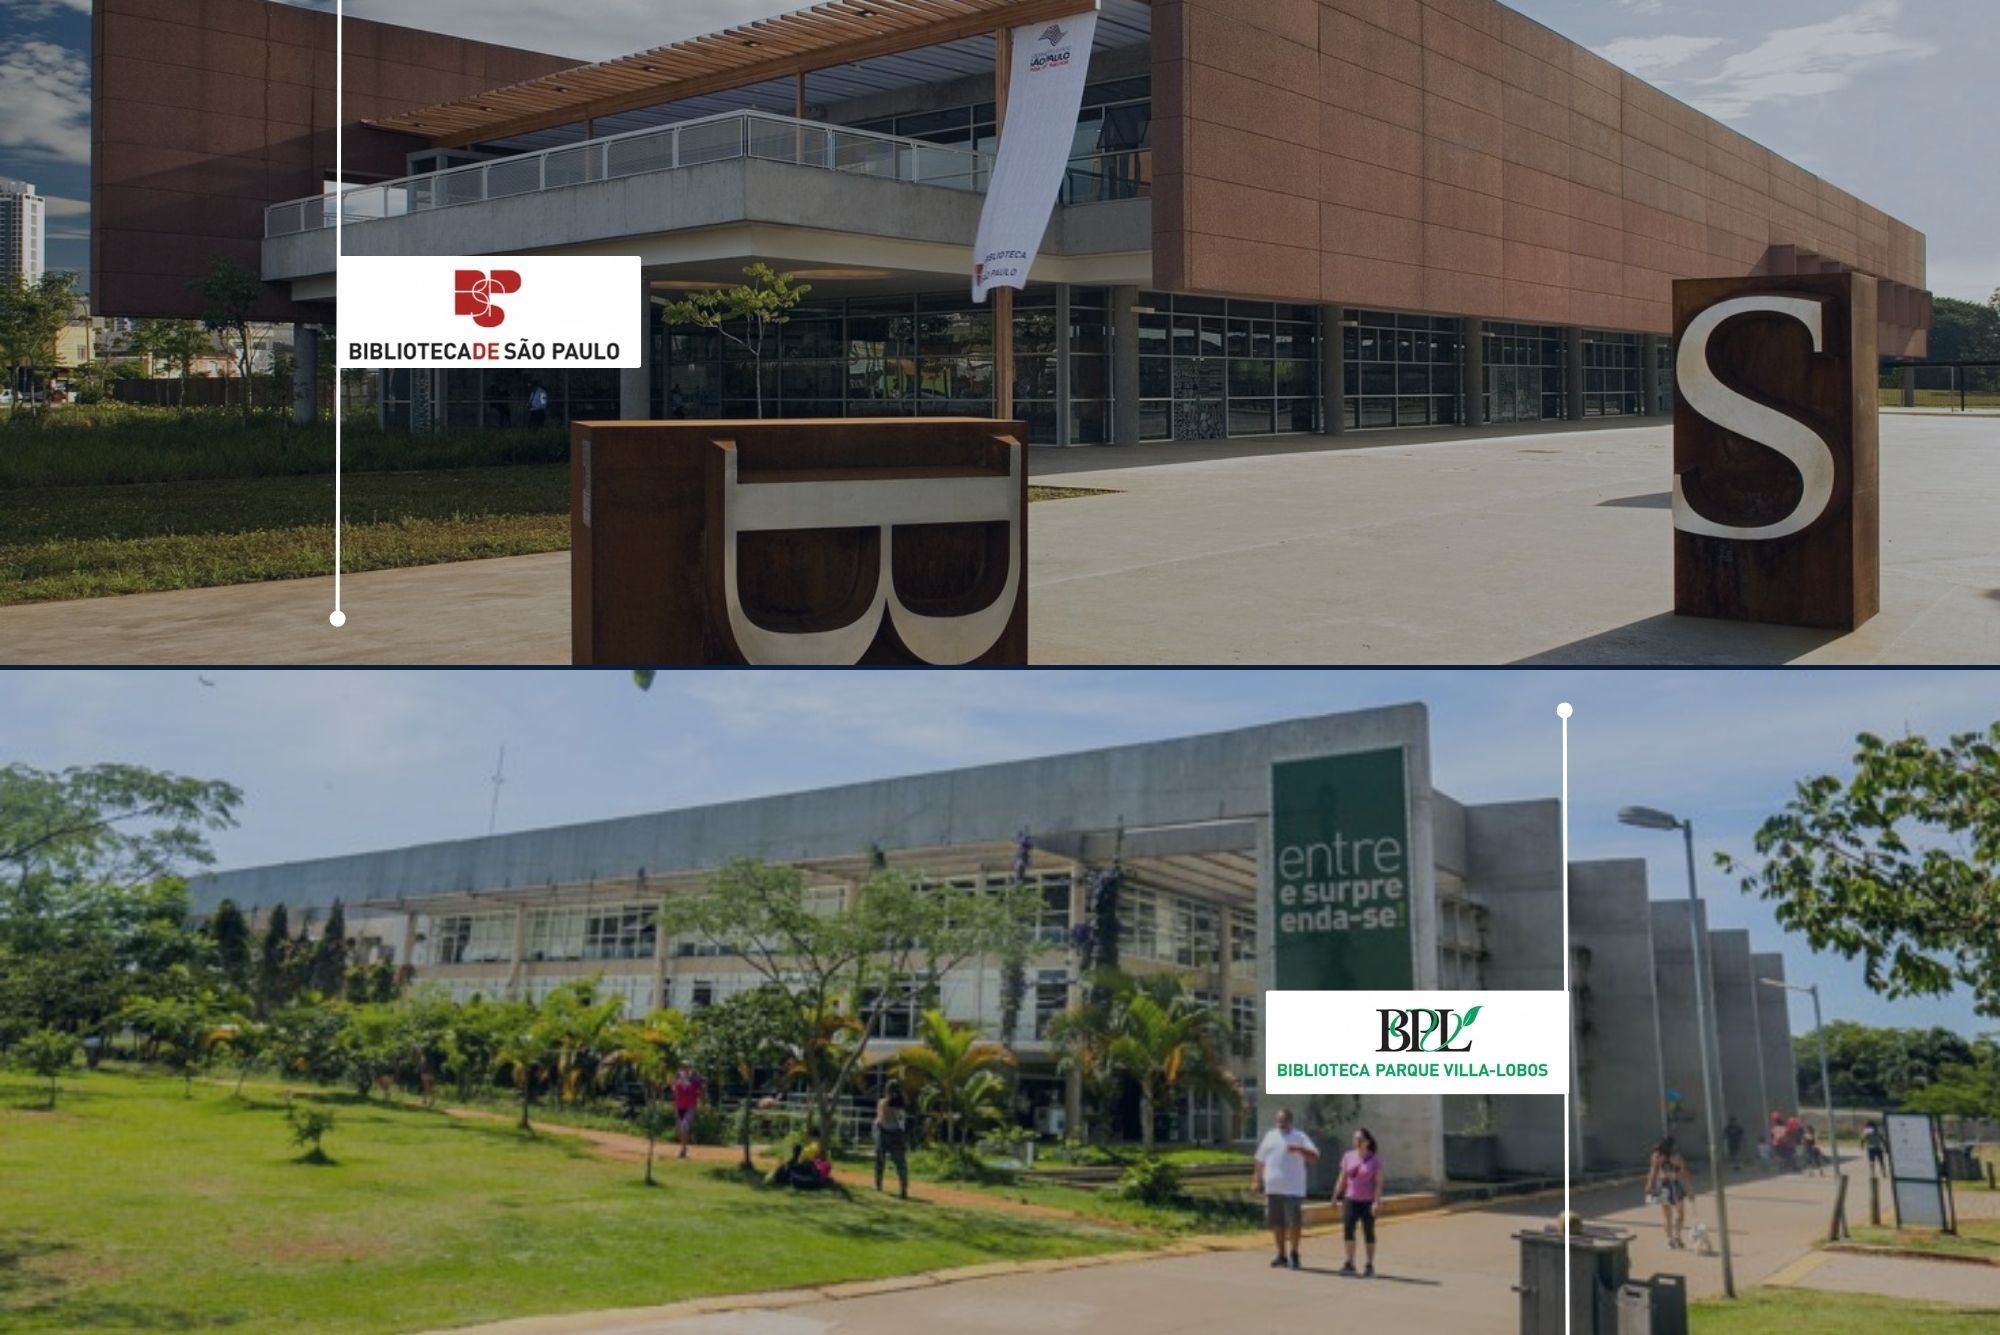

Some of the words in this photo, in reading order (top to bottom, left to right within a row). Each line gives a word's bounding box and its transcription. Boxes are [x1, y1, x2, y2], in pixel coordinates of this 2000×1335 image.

[1672, 295, 1835, 540] S
[1279, 831, 1401, 880] entre
[1280, 884, 1297, 905] e
[1302, 877, 1403, 908] surpre
